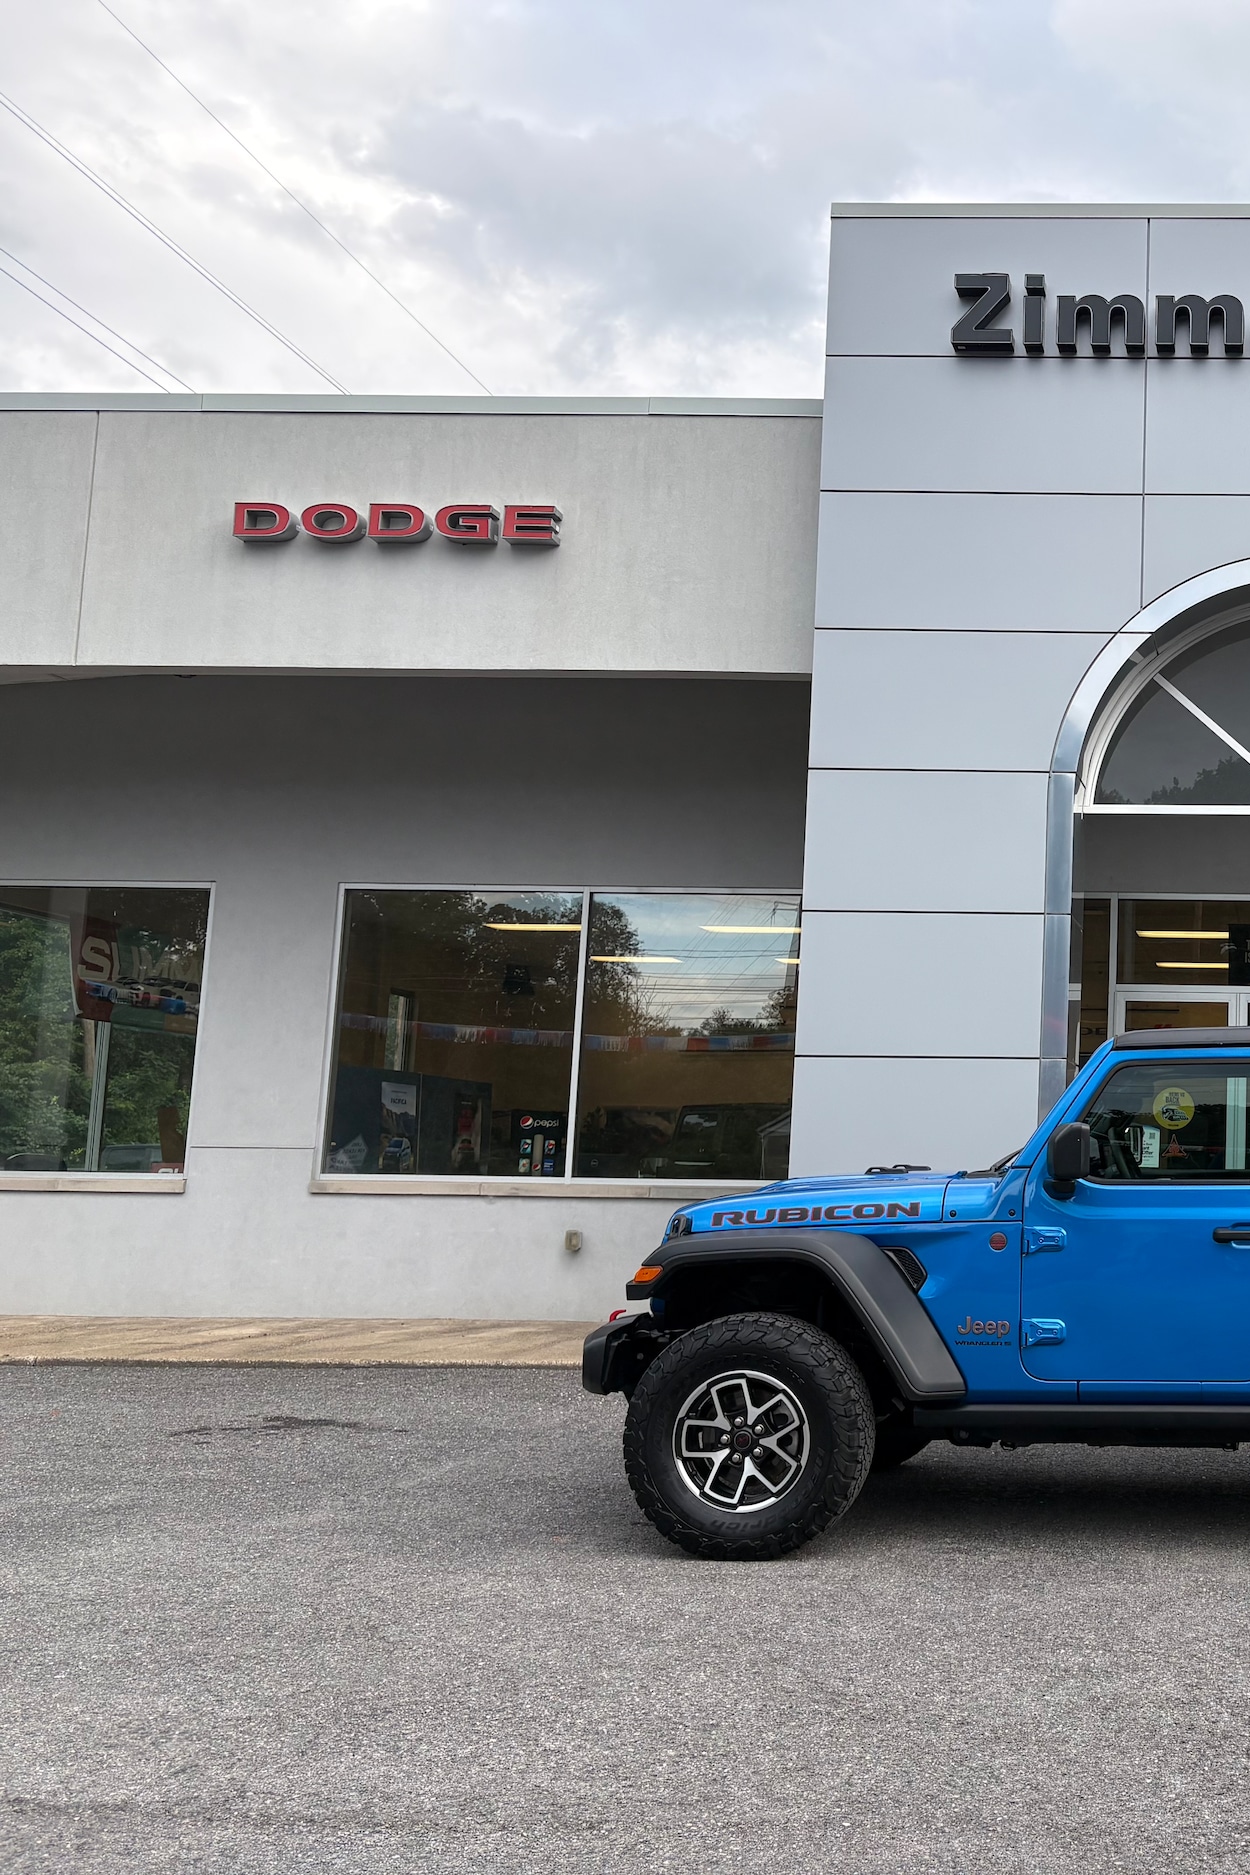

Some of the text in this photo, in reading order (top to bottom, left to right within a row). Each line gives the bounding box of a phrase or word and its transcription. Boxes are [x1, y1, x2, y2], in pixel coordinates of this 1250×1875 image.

[232, 502, 562, 547] DODGE
[533, 1119, 560, 1128] pepsi
[711, 1202, 921, 1227] RUBICON
[957, 1315, 1011, 1338] Jeep
